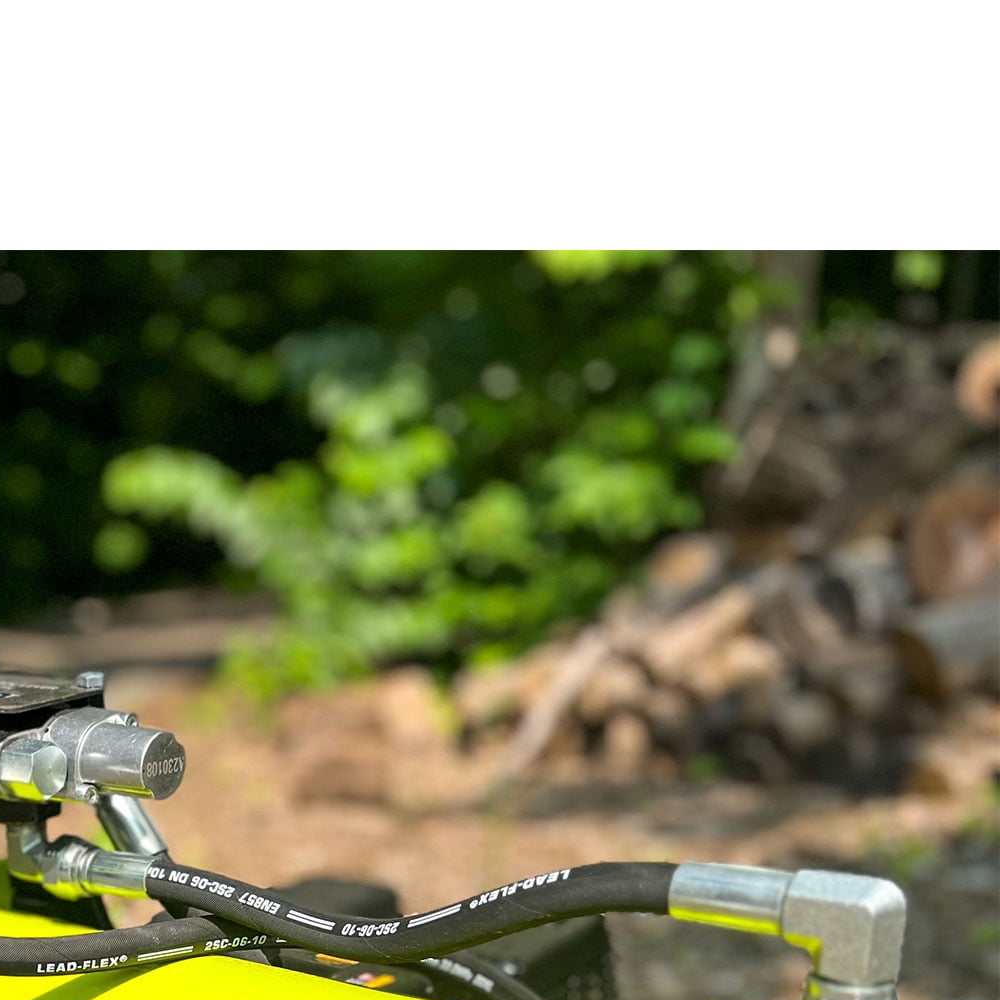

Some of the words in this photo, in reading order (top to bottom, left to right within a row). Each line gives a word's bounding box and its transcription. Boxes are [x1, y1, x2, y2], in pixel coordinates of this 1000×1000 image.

[168, 870, 190, 884] DN
[190, 875, 235, 898] 2SC-06
[238, 892, 281, 915] EN857
[341, 921, 400, 938] 2SC-06-10
[204, 935, 267, 951] 2SC-06-10
